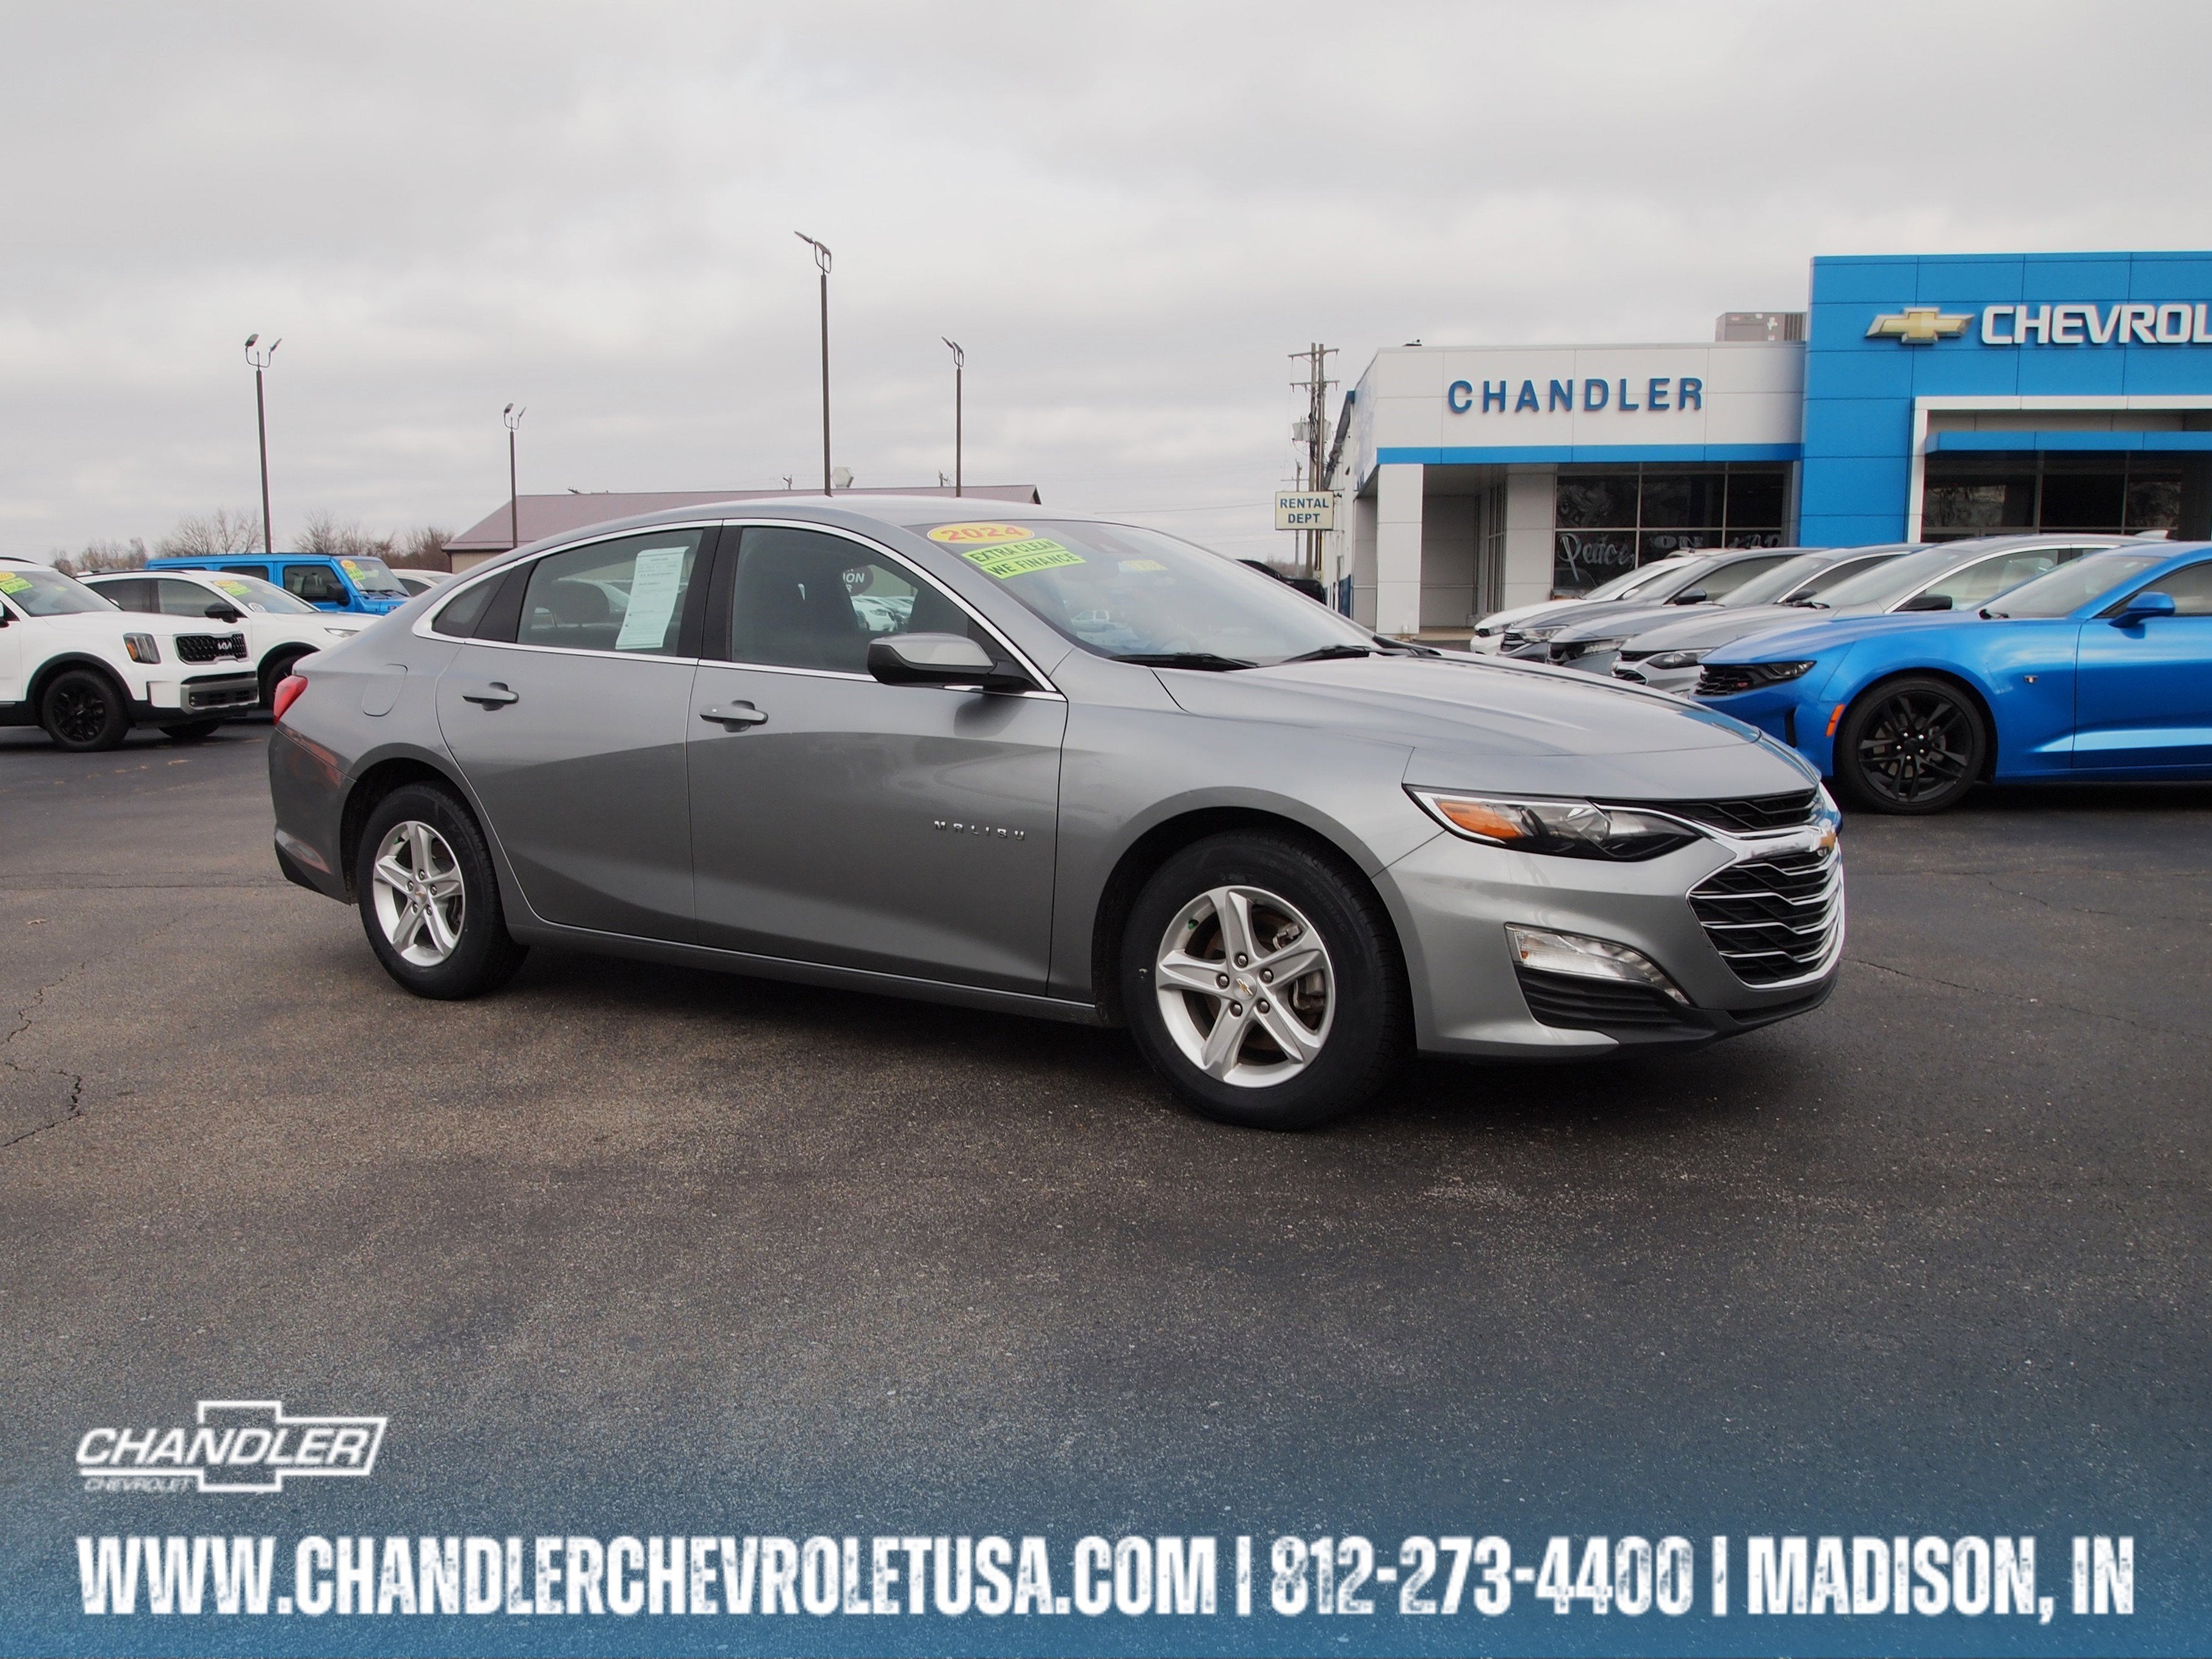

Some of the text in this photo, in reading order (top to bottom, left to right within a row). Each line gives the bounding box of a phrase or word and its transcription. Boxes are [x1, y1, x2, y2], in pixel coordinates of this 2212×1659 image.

[1448, 378, 1703, 413] CHANDLER
[1280, 498, 1329, 509] RENTAL
[941, 526, 1023, 541] 2024
[969, 539, 1058, 563] EXTRA CLEAN
[987, 553, 1080, 576] WE FINANCE
